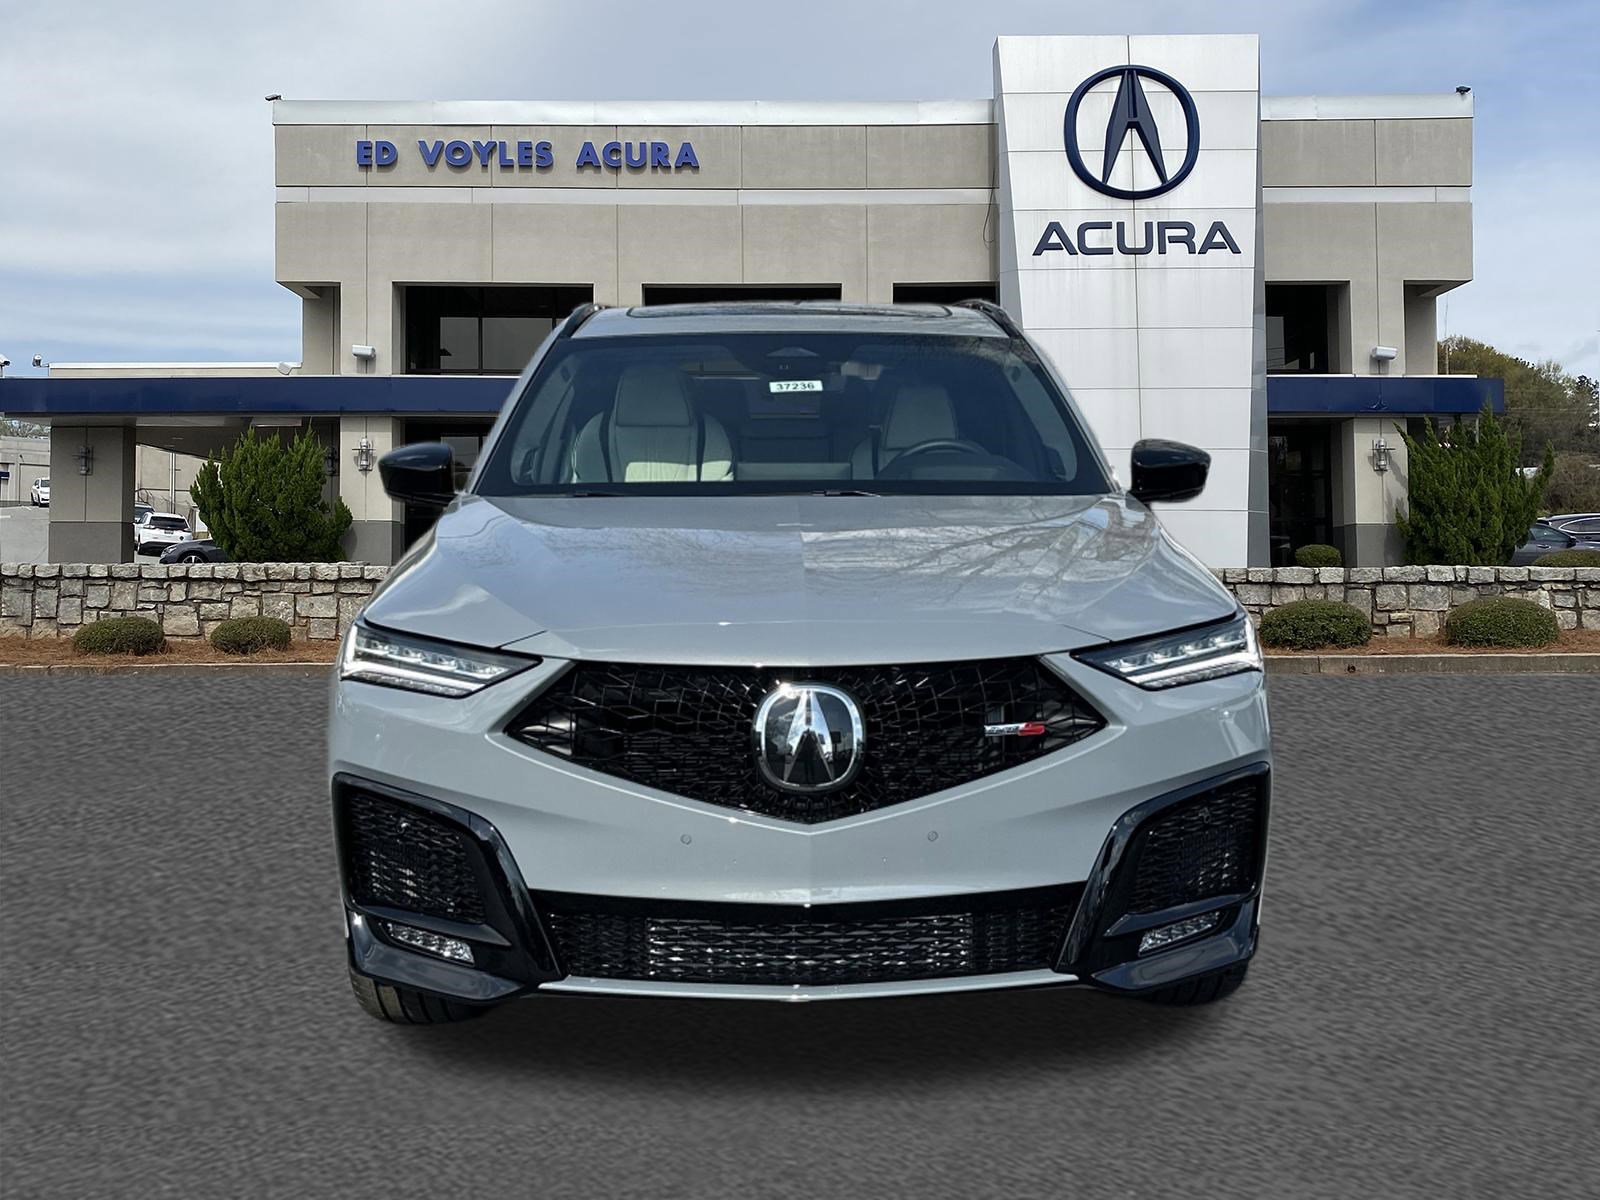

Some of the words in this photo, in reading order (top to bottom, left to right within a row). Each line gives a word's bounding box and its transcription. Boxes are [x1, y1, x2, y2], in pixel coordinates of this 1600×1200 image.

[356, 140, 398, 168] ED
[418, 140, 554, 168] VOYLES
[575, 141, 700, 169] ACURA
[1032, 221, 1242, 256] ACURA
[776, 382, 815, 391] 37236
